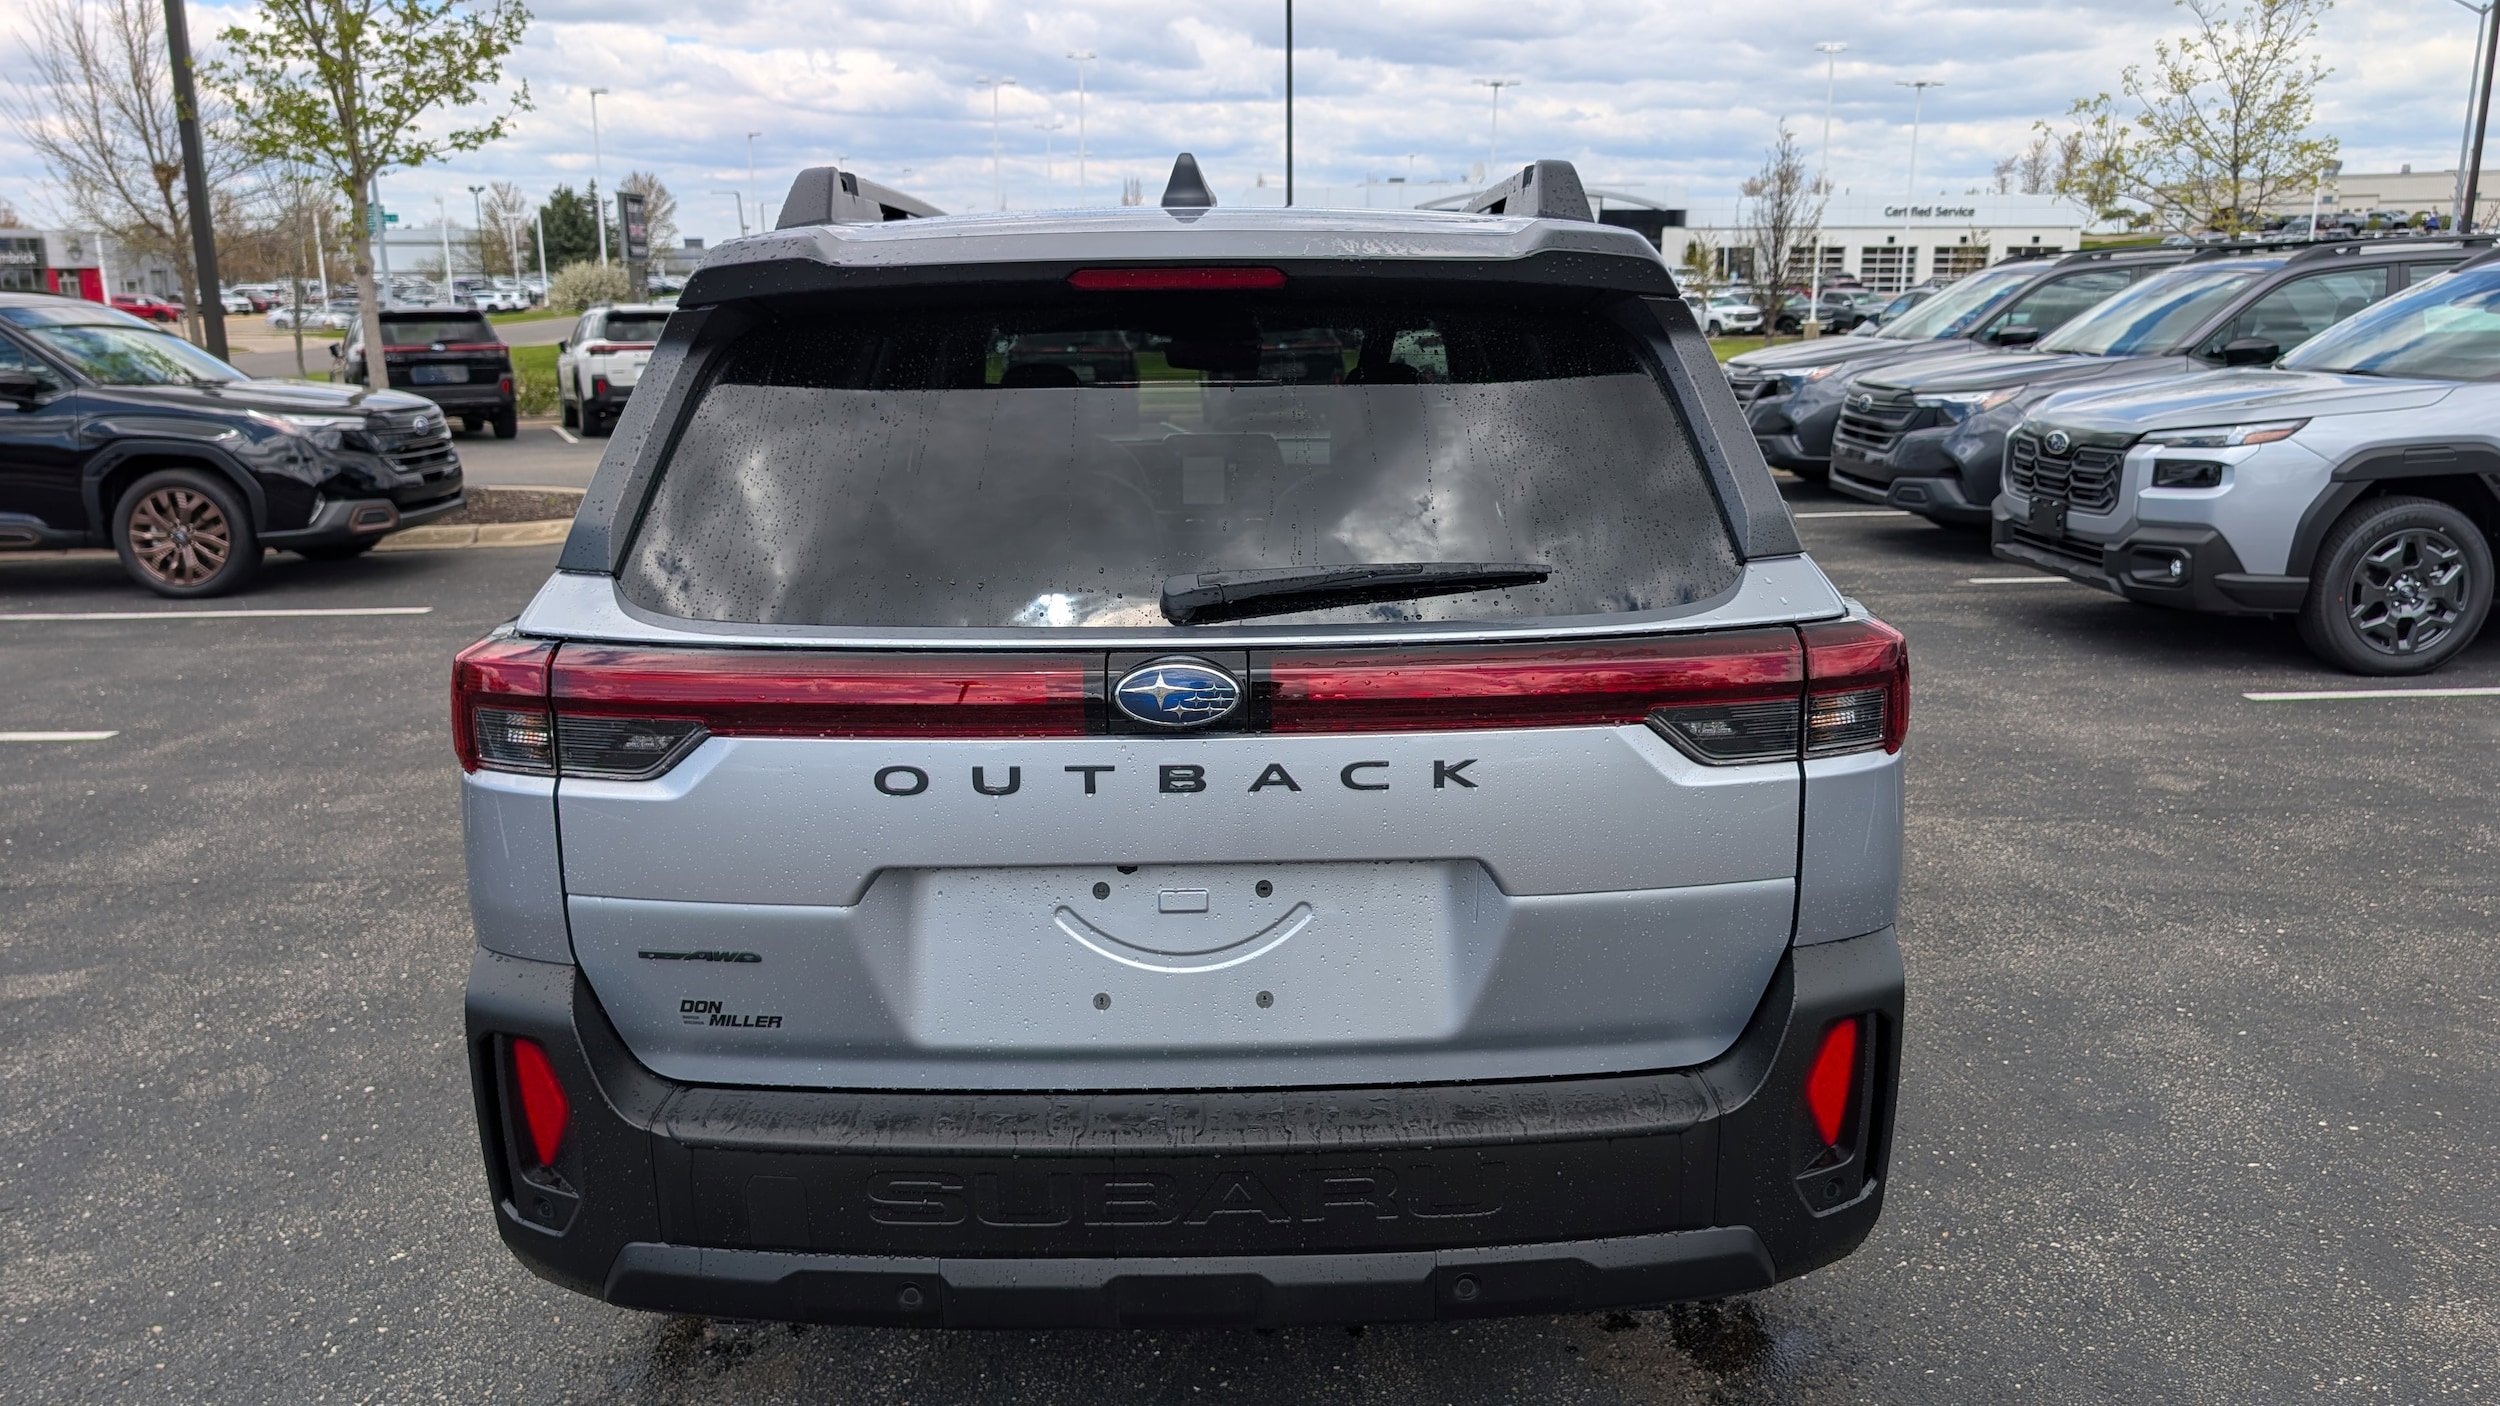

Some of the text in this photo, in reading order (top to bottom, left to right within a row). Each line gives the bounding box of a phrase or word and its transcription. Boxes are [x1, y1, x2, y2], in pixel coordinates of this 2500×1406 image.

[1884, 206, 1976, 218] Certfied Service
[873, 758, 1480, 796] OUTBACK
[679, 1000, 723, 1013] DON
[709, 1014, 783, 1028] MILLER
[866, 1162, 1504, 1228] SUBARU
